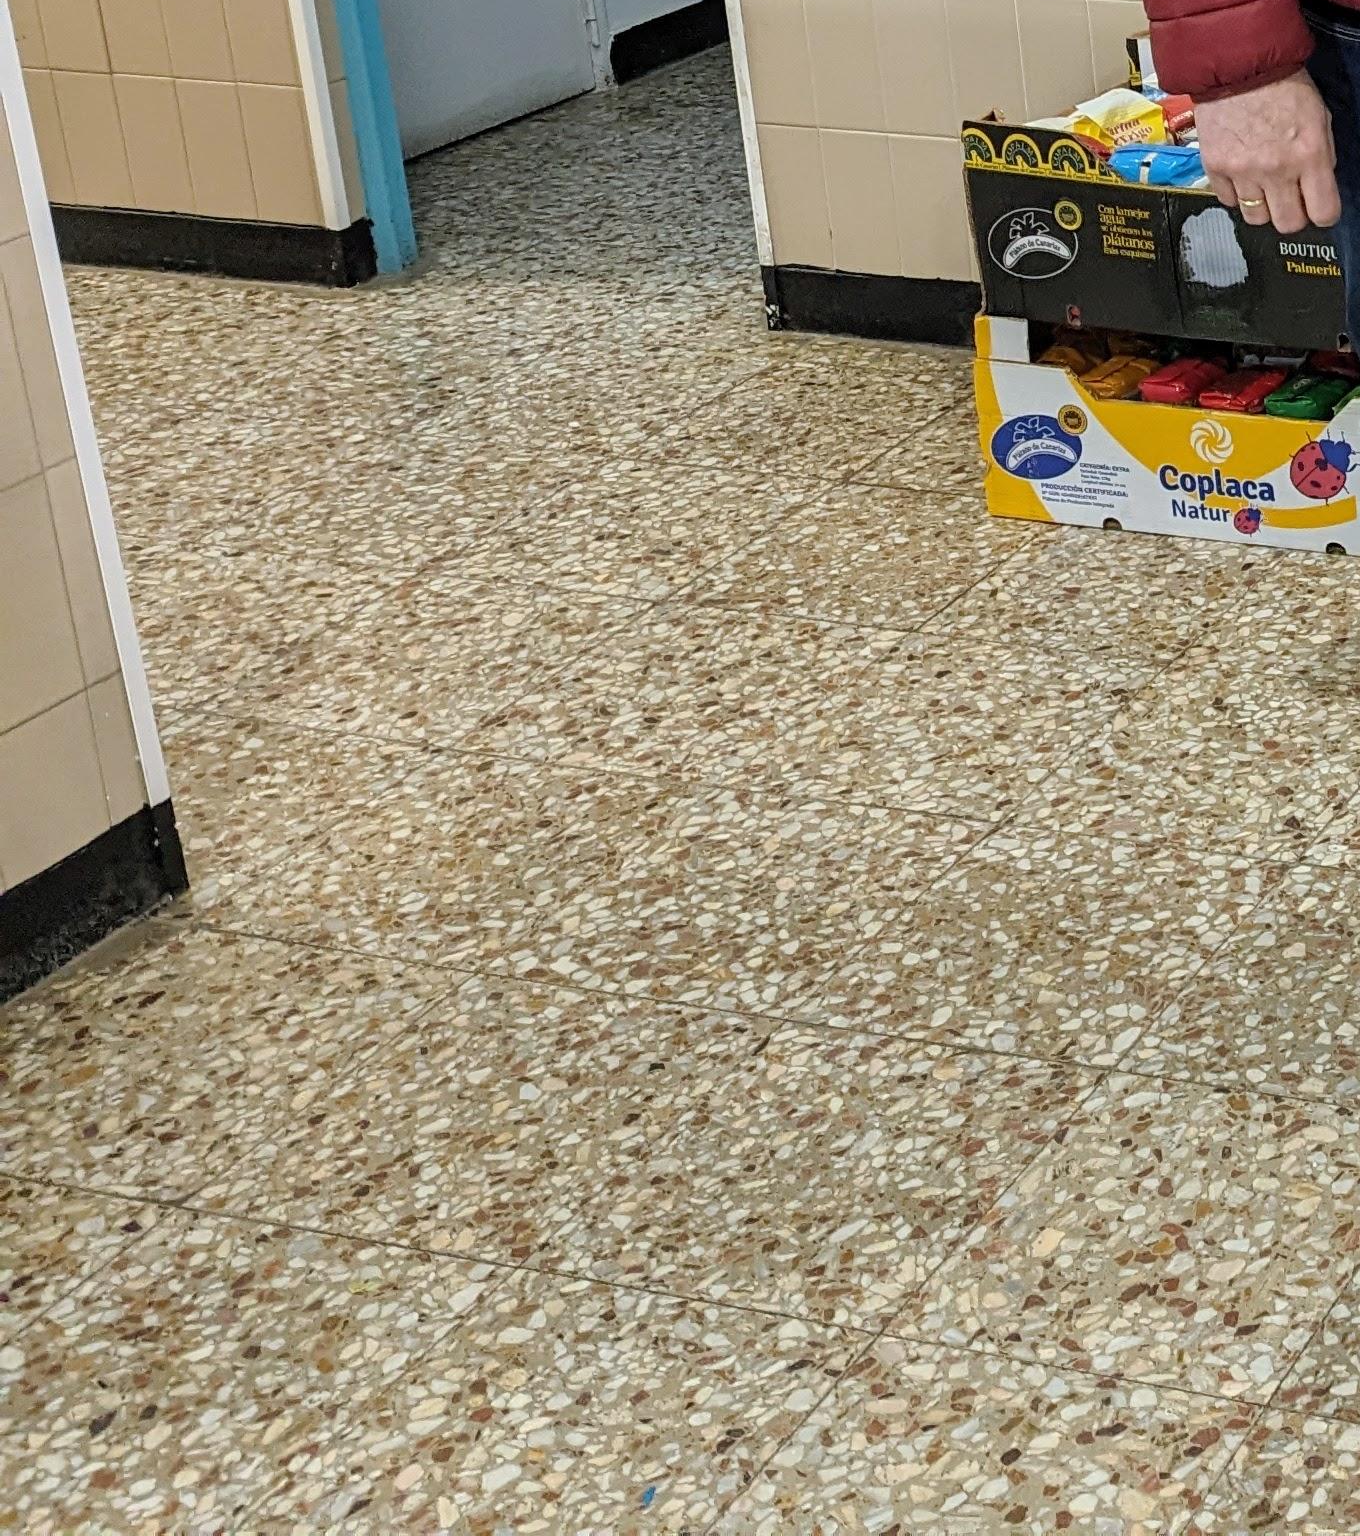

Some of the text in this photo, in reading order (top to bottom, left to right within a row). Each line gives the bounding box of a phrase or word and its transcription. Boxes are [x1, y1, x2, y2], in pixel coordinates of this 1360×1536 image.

[1098, 204, 1114, 214] Con
[1100, 214, 1126, 226] agua
[1103, 232, 1155, 251] plátanos
[1279, 242, 1338, 260] BOUTIQU
[1160, 465, 1275, 502] Coplaca
[1172, 499, 1230, 523] Natur
